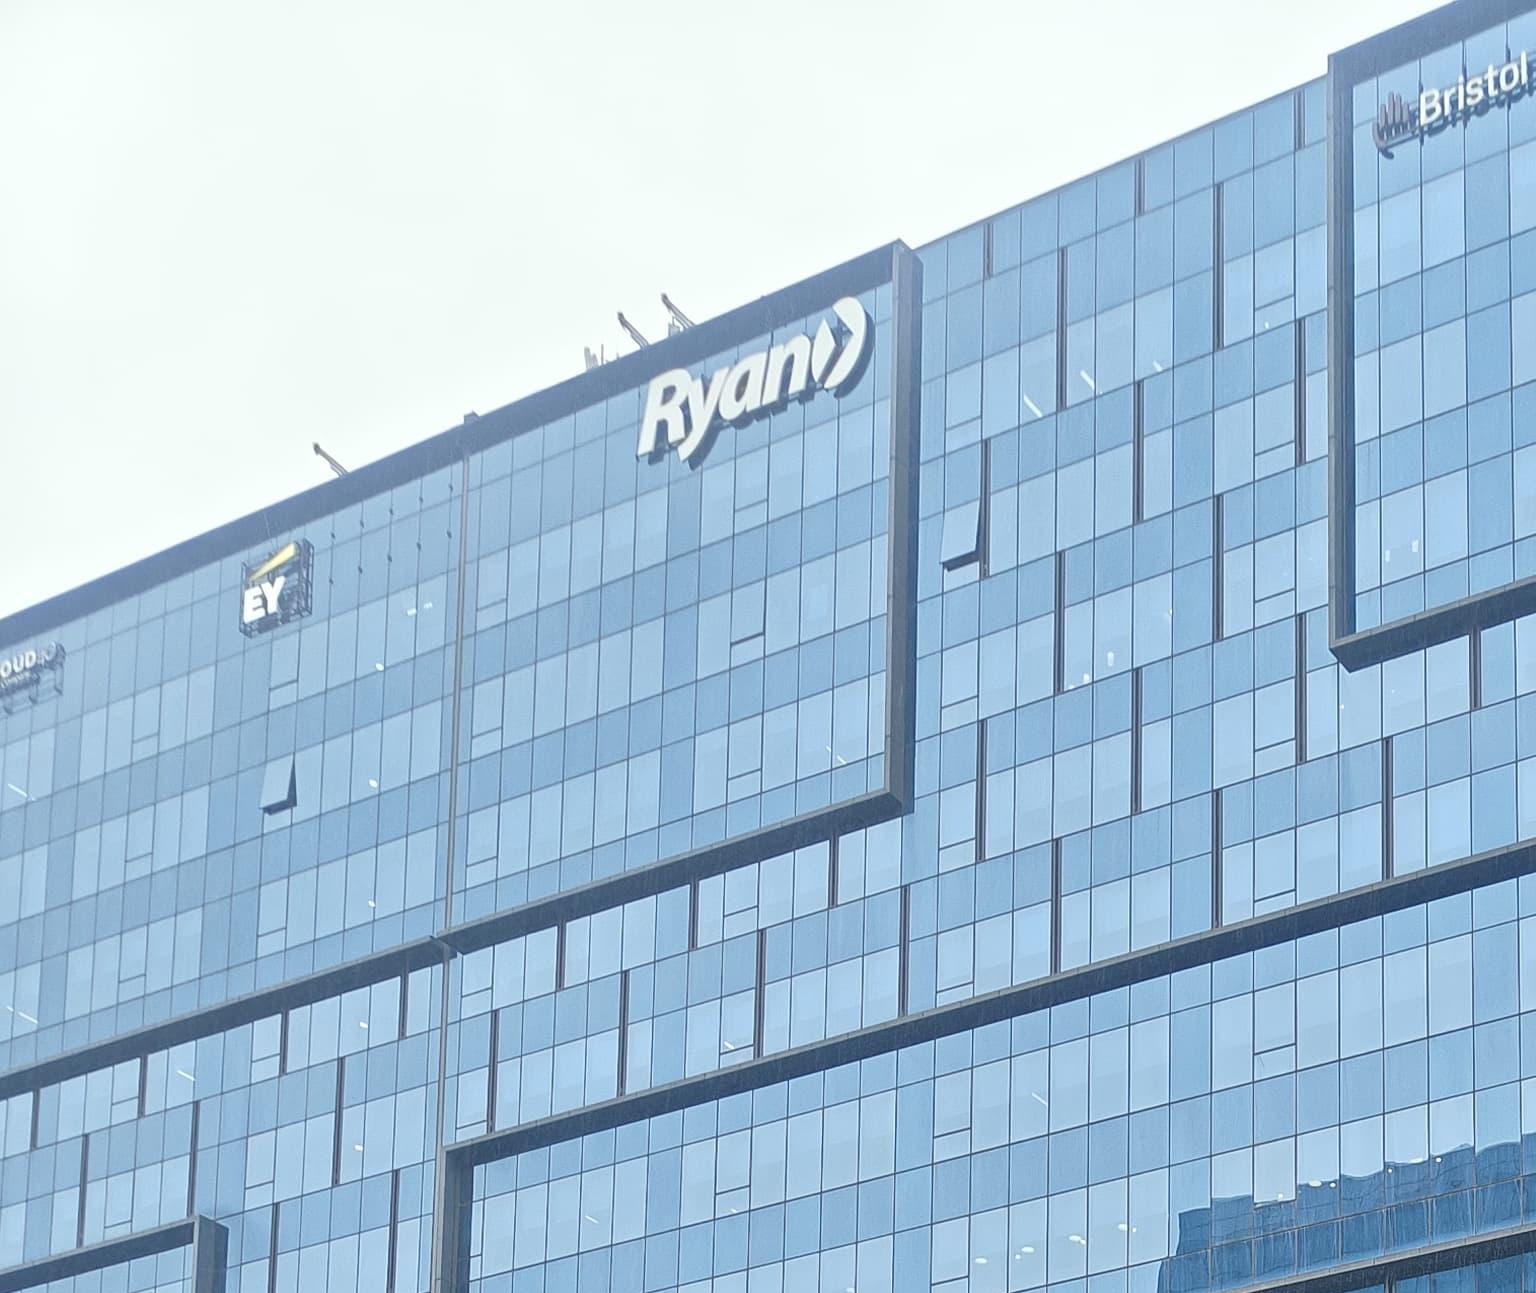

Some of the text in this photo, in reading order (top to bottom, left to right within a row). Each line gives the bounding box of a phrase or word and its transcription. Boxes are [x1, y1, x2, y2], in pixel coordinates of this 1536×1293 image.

[1420, 52, 1527, 125] Bristol
[637, 334, 811, 462] Ryan
[243, 576, 286, 624] EY
